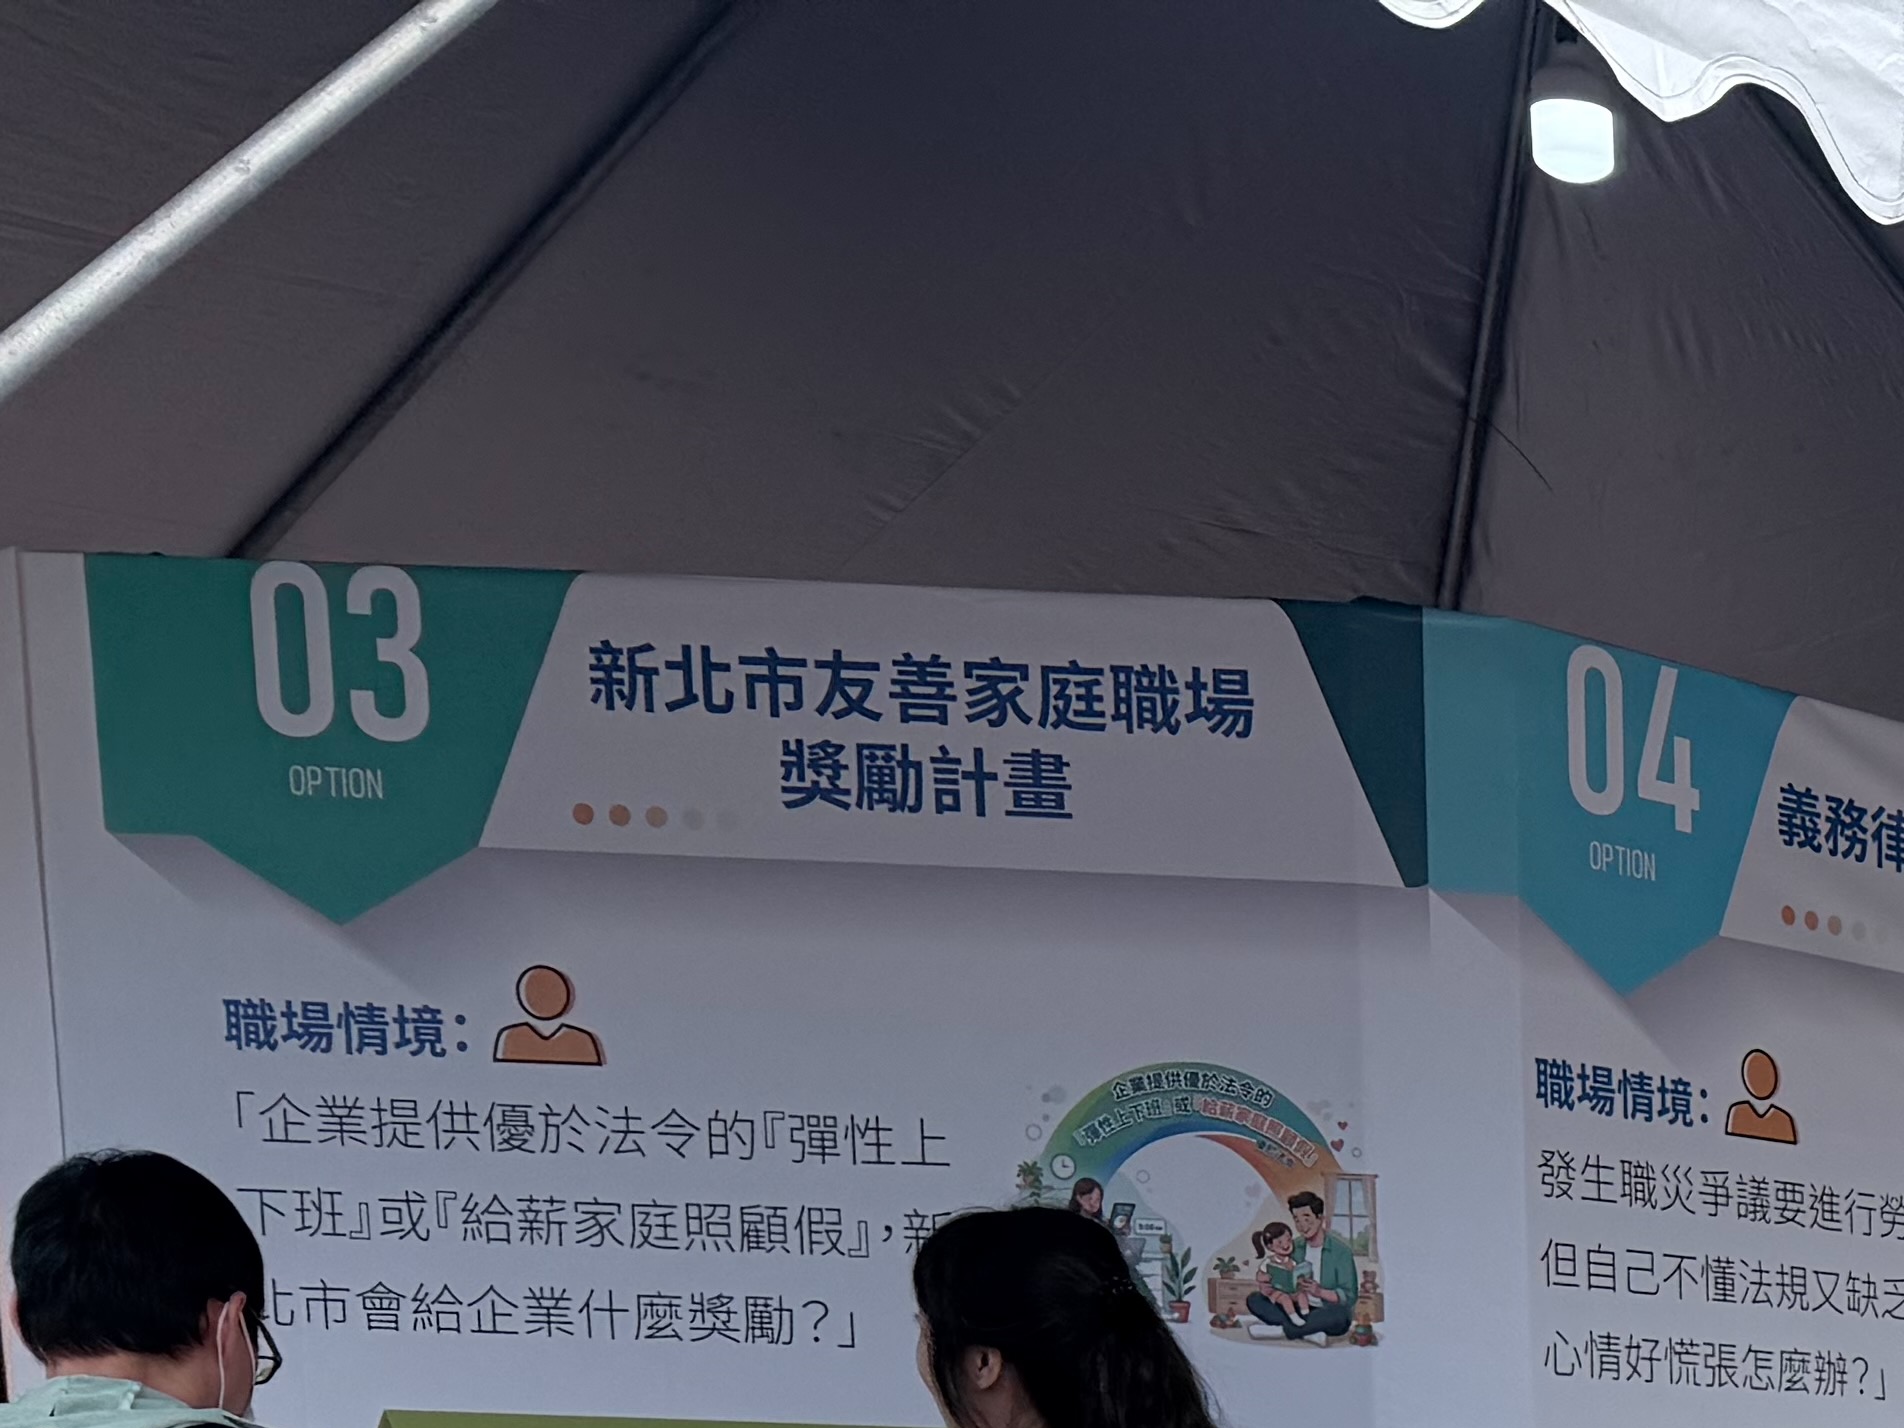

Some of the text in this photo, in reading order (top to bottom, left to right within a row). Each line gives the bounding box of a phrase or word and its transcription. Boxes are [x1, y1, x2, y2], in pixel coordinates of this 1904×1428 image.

[248, 560, 430, 744] 03
[588, 638, 1255, 739] 新北市友善家庭職場
[1565, 643, 1701, 834] 04
[288, 763, 385, 800] OPTION
[779, 736, 1073, 822] 獎勵計畫
[1589, 840, 1657, 882] OPTION
[222, 998, 470, 1061] 職場情境：
[1535, 1057, 1709, 1127] 職場情境：
[234, 1095, 949, 1171] 「企業提供優於法令的『彈性上
[1543, 1336, 1888, 1402] 心情好慌張怎麼辦？」
